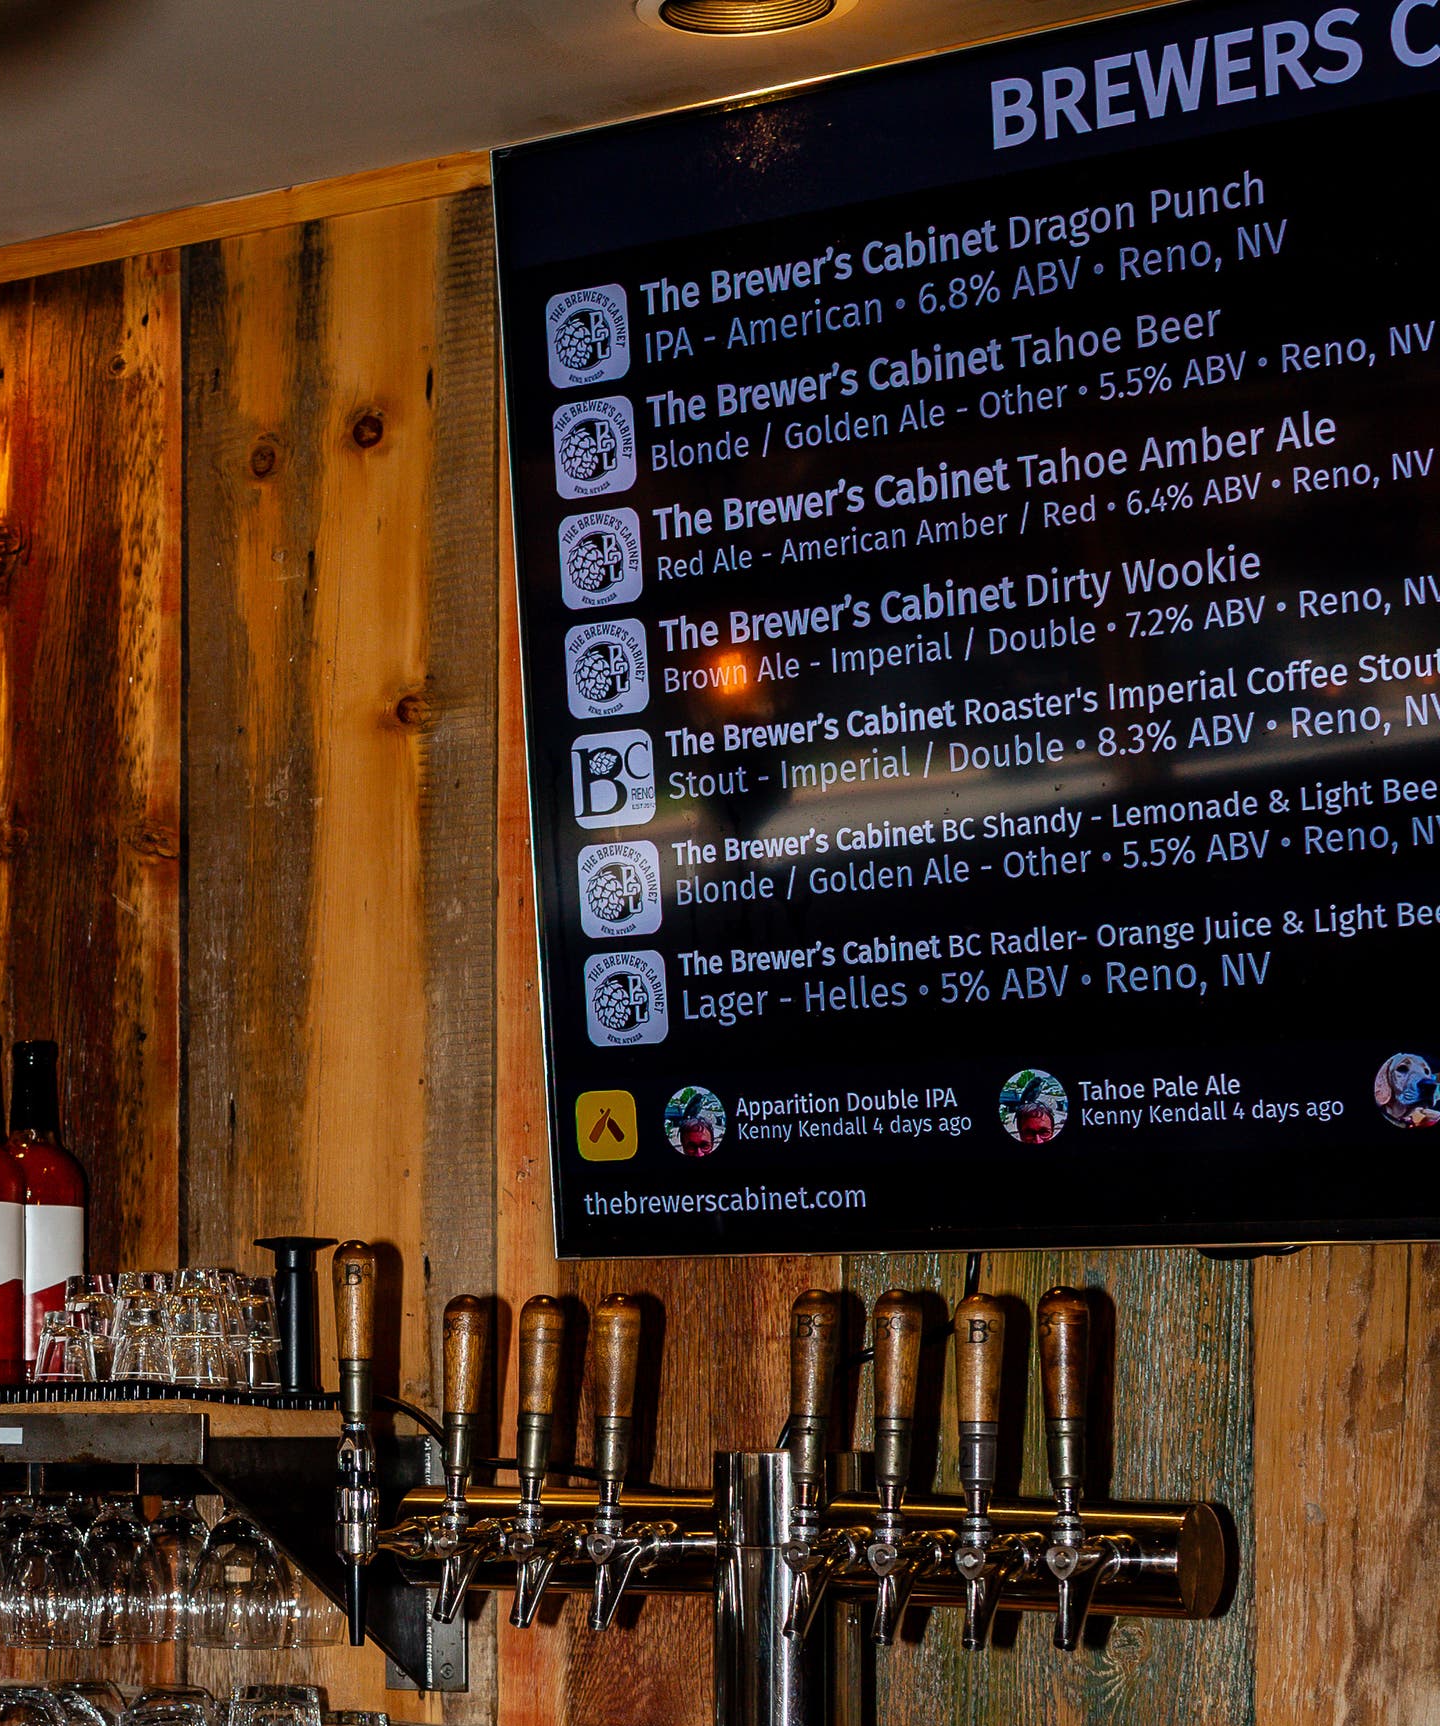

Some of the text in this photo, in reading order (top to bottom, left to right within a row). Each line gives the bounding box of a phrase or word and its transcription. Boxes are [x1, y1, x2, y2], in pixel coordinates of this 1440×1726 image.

[990, 7, 1363, 151] BREWERS
[639, 169, 1265, 316] The Brewer's Cabinet Dragon Punch
[645, 218, 1288, 364] IPA American 6.8% ABV Reno, NV
[645, 309, 1222, 428] The Brewer's Cabinet Tahoe Beer
[657, 447, 1435, 581] Red Ale American Amber Red 6.4% ABV Reno, NV
[664, 726, 715, 758] The
[723, 711, 840, 752] Brewer's
[846, 700, 958, 738] Cabinet
[964, 686, 1099, 726] Roaster's
[1108, 667, 1238, 714] Imperial
[1246, 658, 1349, 695] Coffee
[677, 949, 723, 977] The
[730, 940, 836, 974] Brewer's
[842, 934, 943, 965] Cabinet
[948, 933, 982, 958] BC
[1096, 921, 1195, 950] Orange
[1203, 911, 1272, 945] Juice
[1282, 910, 1305, 935] &
[1314, 903, 1388, 938] Light
[682, 951, 1271, 1027] Lager Helles 5% ABV Reno, NV
[735, 1087, 958, 1122] Apparition Double IPA
[737, 1114, 972, 1143] Kenny Kendall 4 days ago
[1077, 1073, 1241, 1102] Tahoe Pale Ale
[583, 1185, 867, 1216] thebrewerscabinet.com
